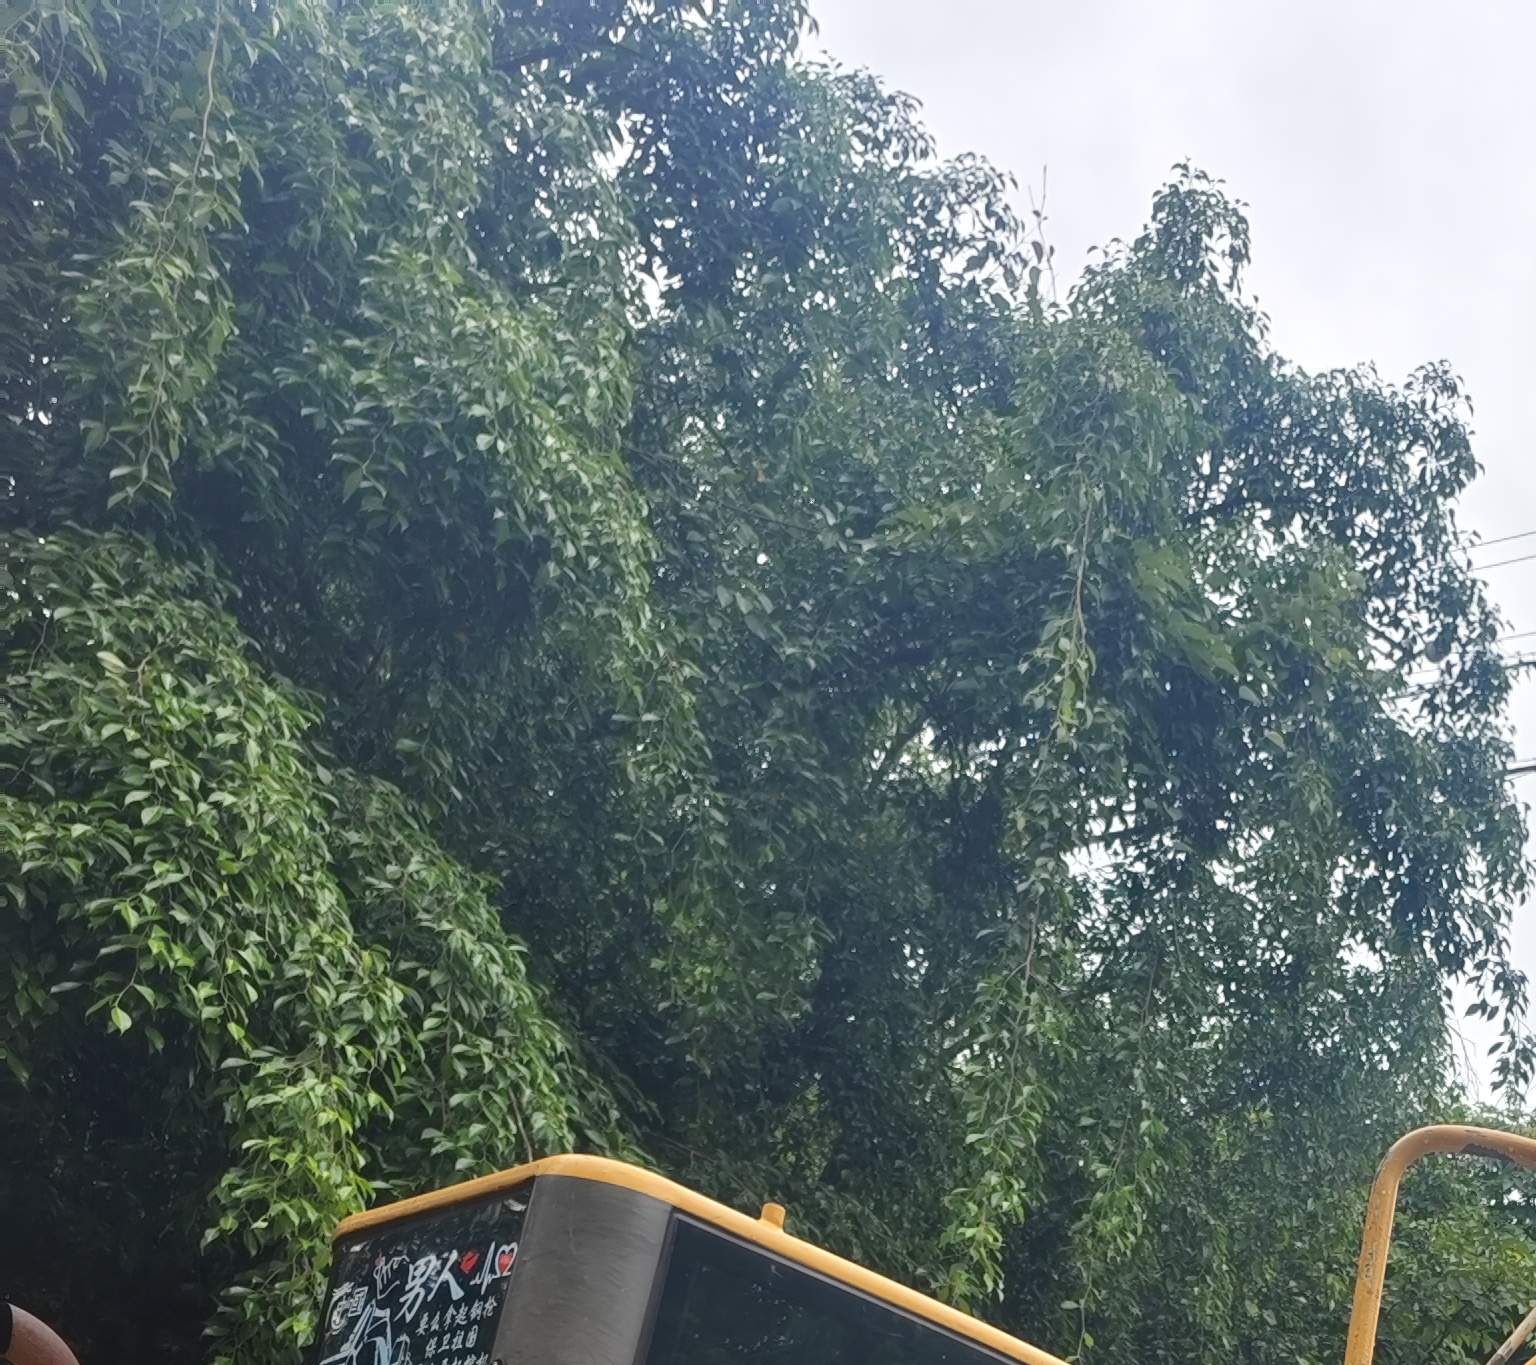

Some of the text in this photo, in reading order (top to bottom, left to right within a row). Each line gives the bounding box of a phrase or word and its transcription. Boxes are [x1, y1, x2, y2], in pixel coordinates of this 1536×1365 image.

[395, 1249, 465, 1324] 男人
[416, 1295, 498, 1336] 要么拿起钢枪
[424, 1325, 479, 1359] 保卫祖国
